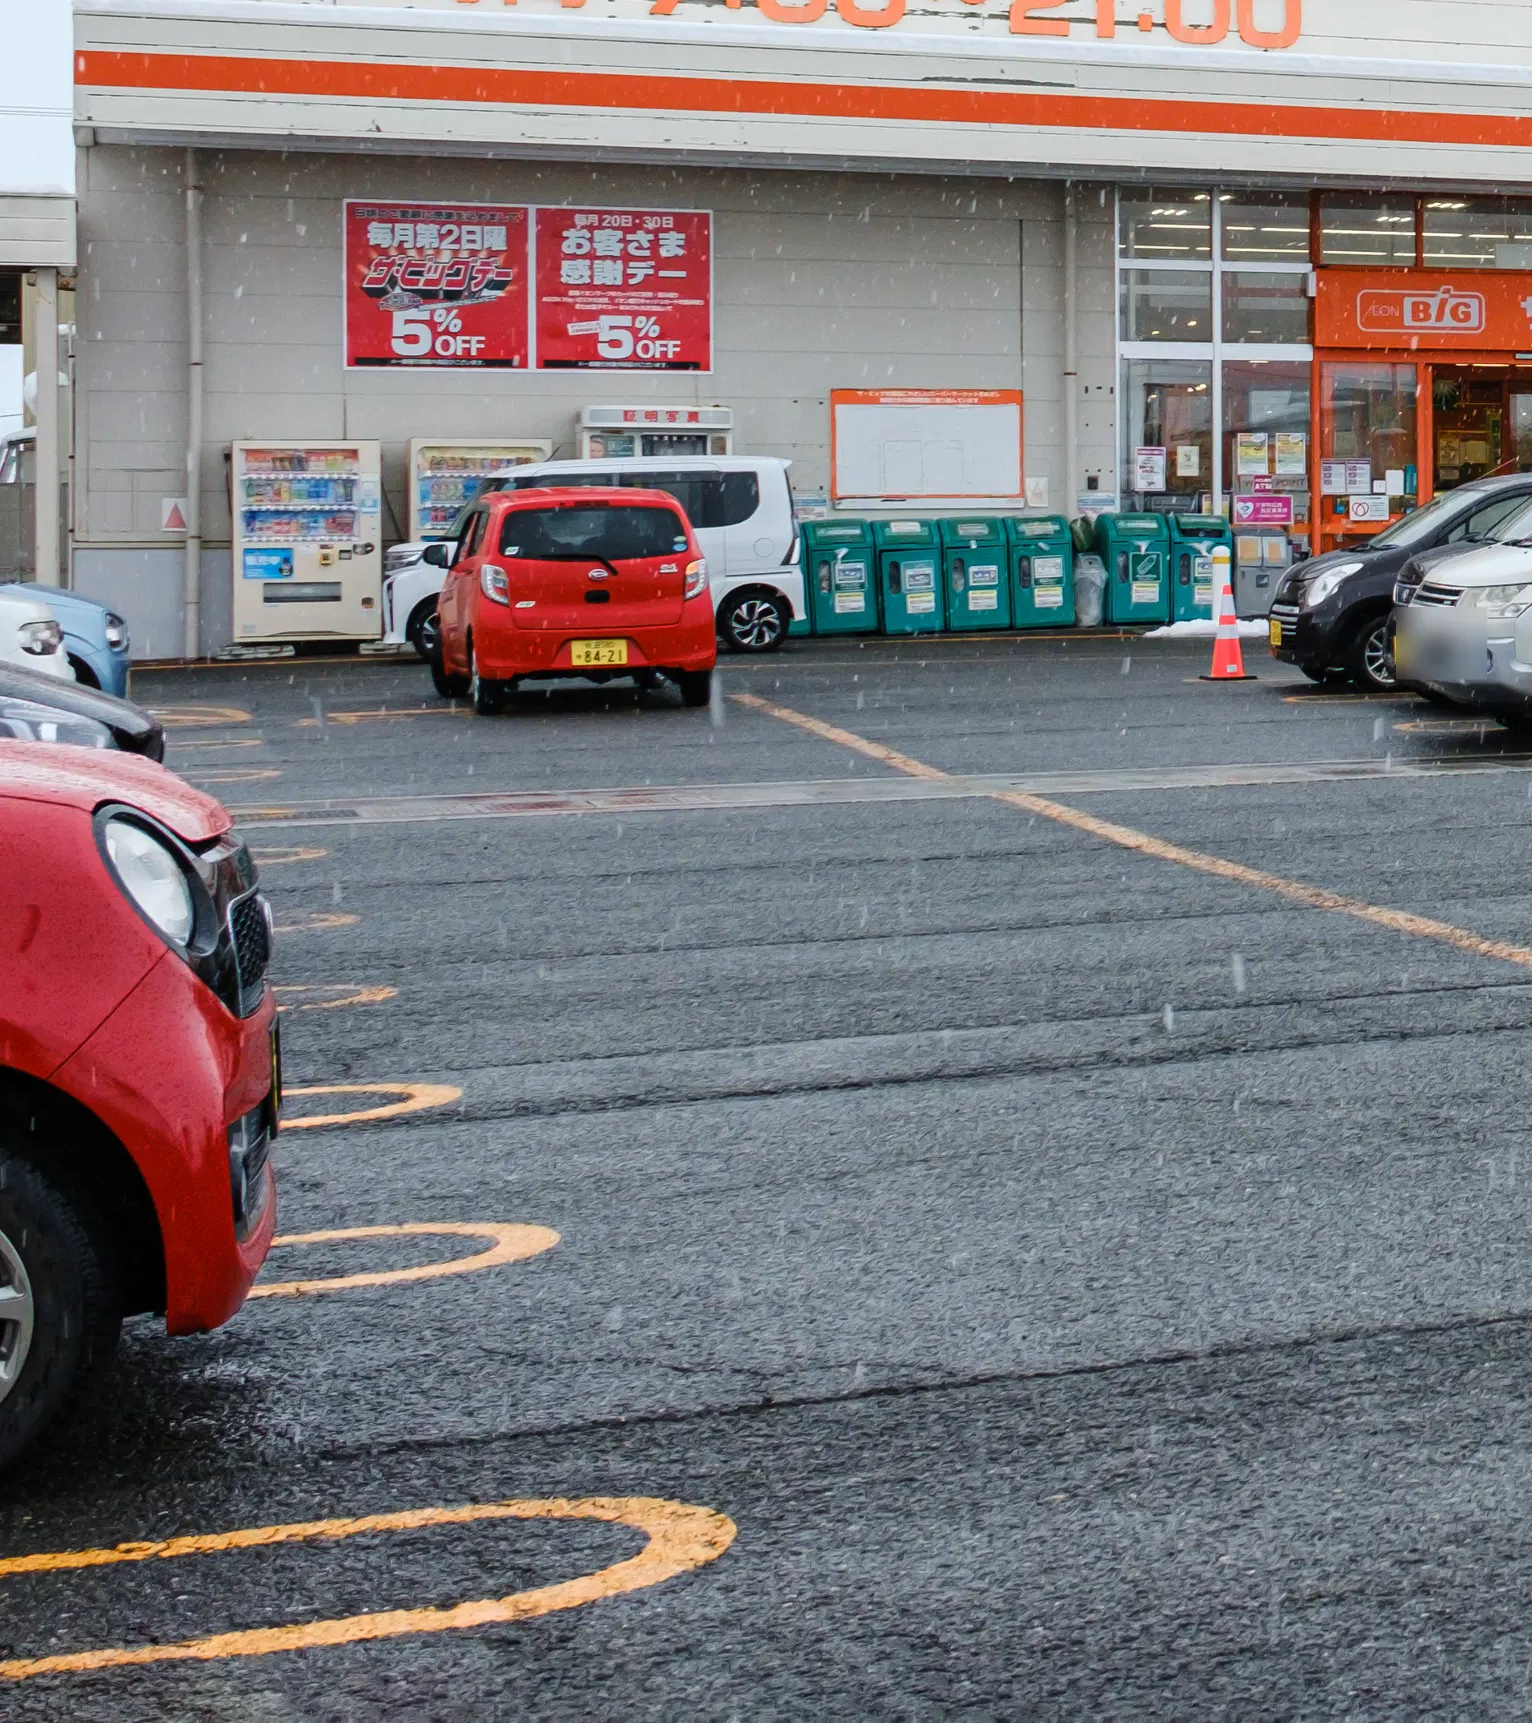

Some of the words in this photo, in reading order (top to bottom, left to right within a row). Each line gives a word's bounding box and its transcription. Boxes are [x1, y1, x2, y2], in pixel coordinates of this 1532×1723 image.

[368, 222, 507, 251] 毎月第2日曜
[561, 229, 686, 257] お客さま
[361, 254, 513, 294] ザ・ビッグデー
[560, 259, 687, 286] 感謝デー
[435, 336, 486, 356] OFF
[636, 340, 681, 359] OFF
